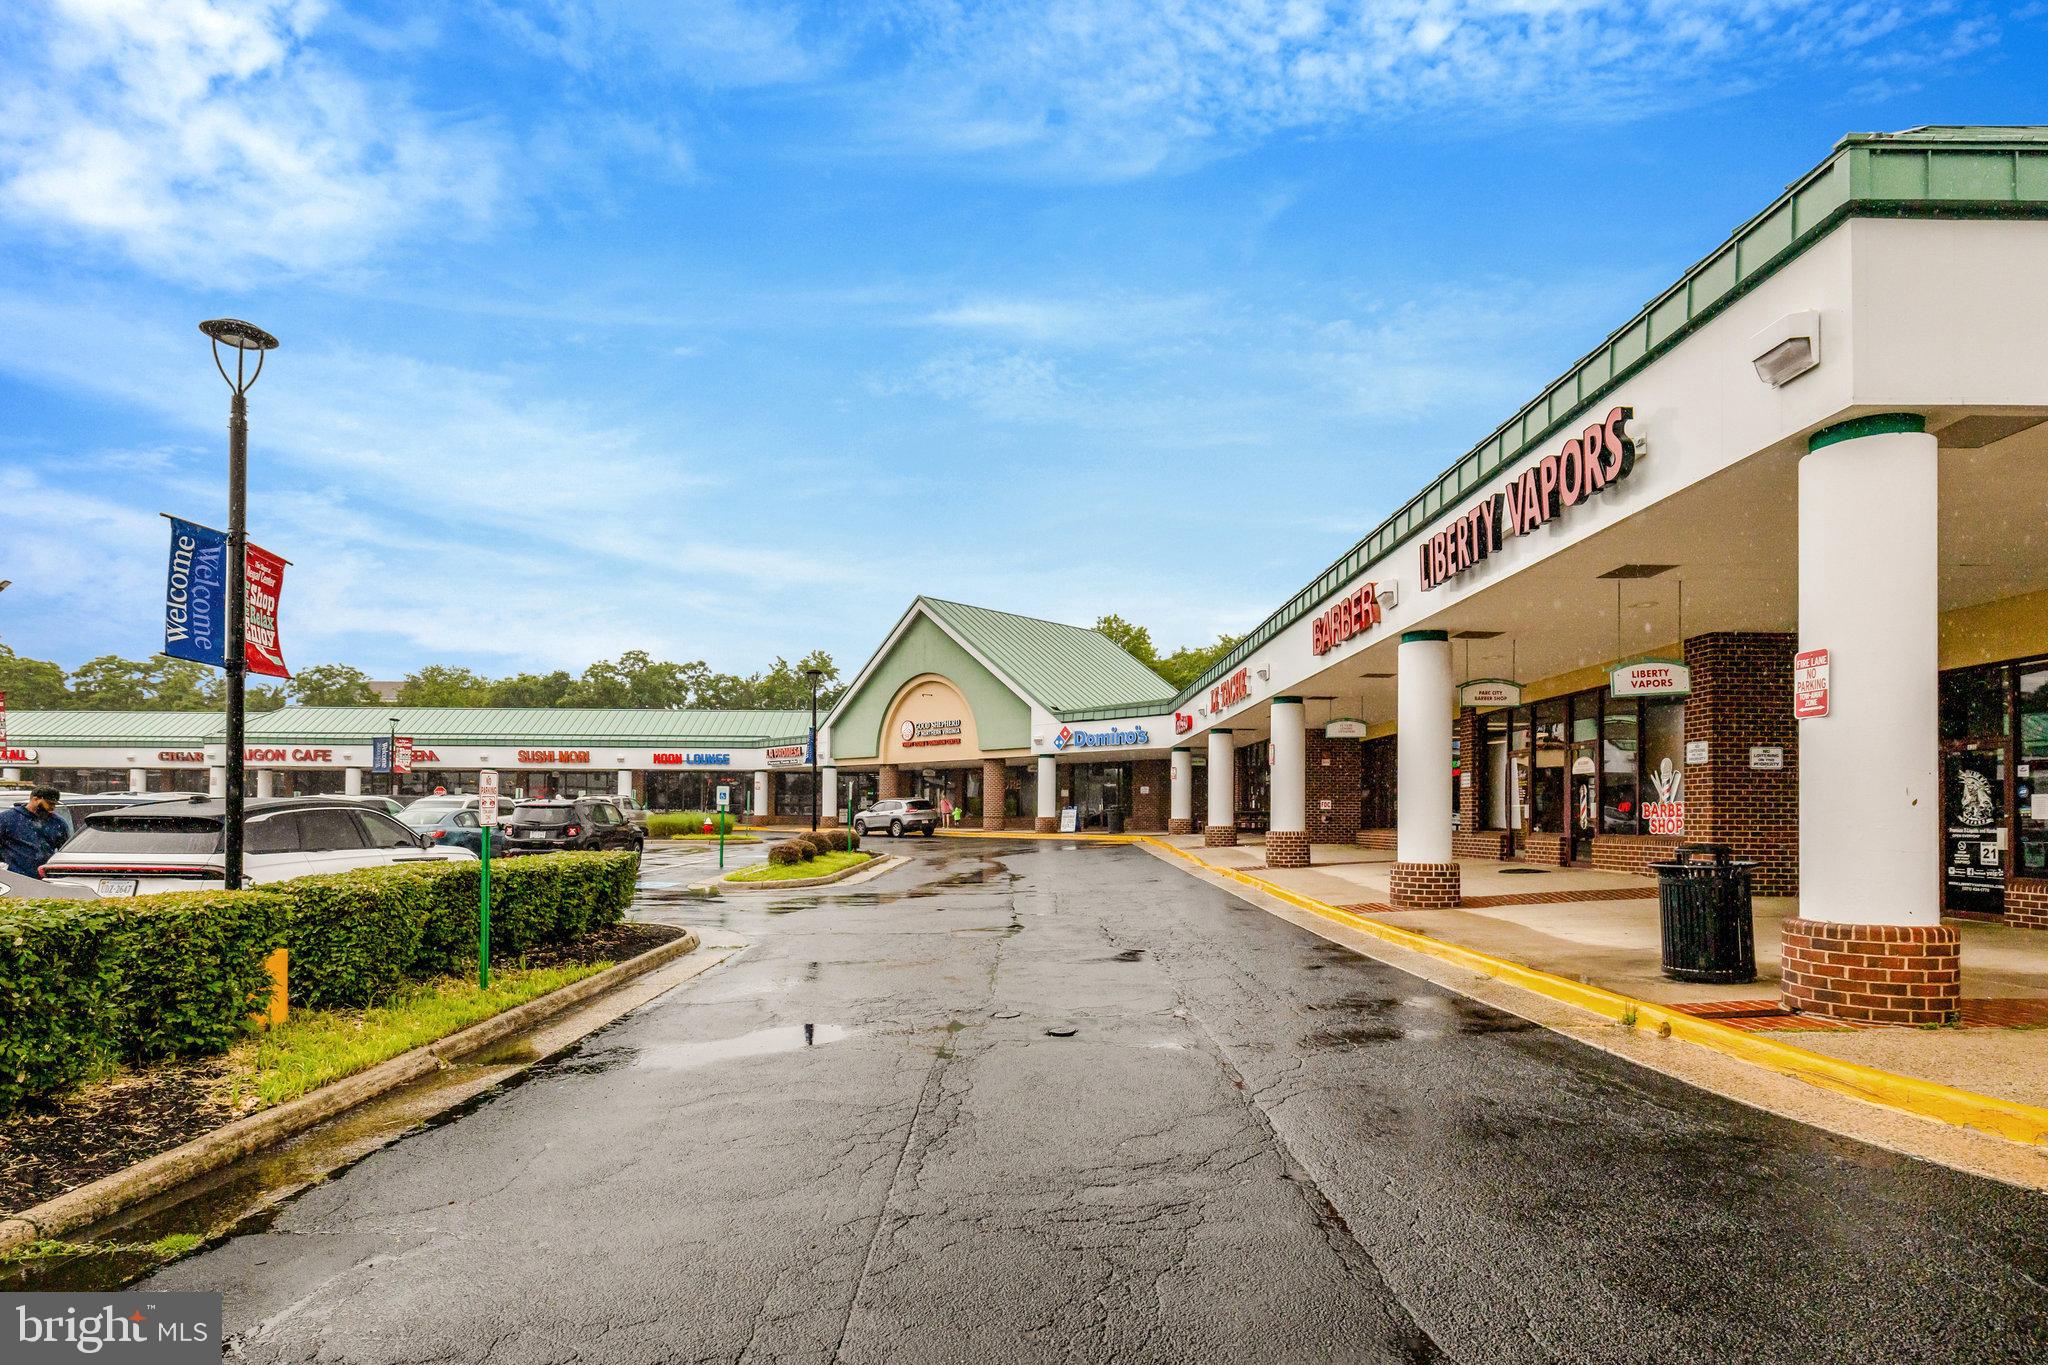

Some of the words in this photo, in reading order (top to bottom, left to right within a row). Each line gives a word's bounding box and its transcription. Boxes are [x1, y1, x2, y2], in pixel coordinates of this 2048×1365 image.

[1419, 493, 1505, 592] LIBERTY
[1505, 406, 1636, 537] VAPORS
[166, 535, 196, 643] Welcome
[191, 545, 222, 650] Welcome
[250, 583, 275, 615] Shop
[250, 605, 275, 631] Relax
[1313, 582, 1380, 656] BARBER
[245, 617, 275, 648] Enjoy
[1797, 658, 1810, 669] FIRE
[1811, 655, 1827, 667] LANE
[1631, 668, 1670, 679] LIBERTY
[1807, 668, 1816, 679] NO
[1221, 667, 1247, 708] TACHE
[1631, 679, 1673, 689] VAPORS
[1797, 678, 1826, 692] PARKING
[1805, 699, 1818, 707] ZONE
[1073, 725, 1149, 747] Domino's
[243, 749, 286, 762] AIGON
[292, 749, 332, 762] CAFE
[517, 750, 555, 763] SUSHI
[559, 750, 590, 763] MORI
[686, 753, 731, 765] LOUNGE
[481, 786, 497, 794] PARKING
[1643, 802, 1684, 819] BARBE
[1650, 818, 1684, 833] SHOP
[1982, 848, 1997, 859] 21
